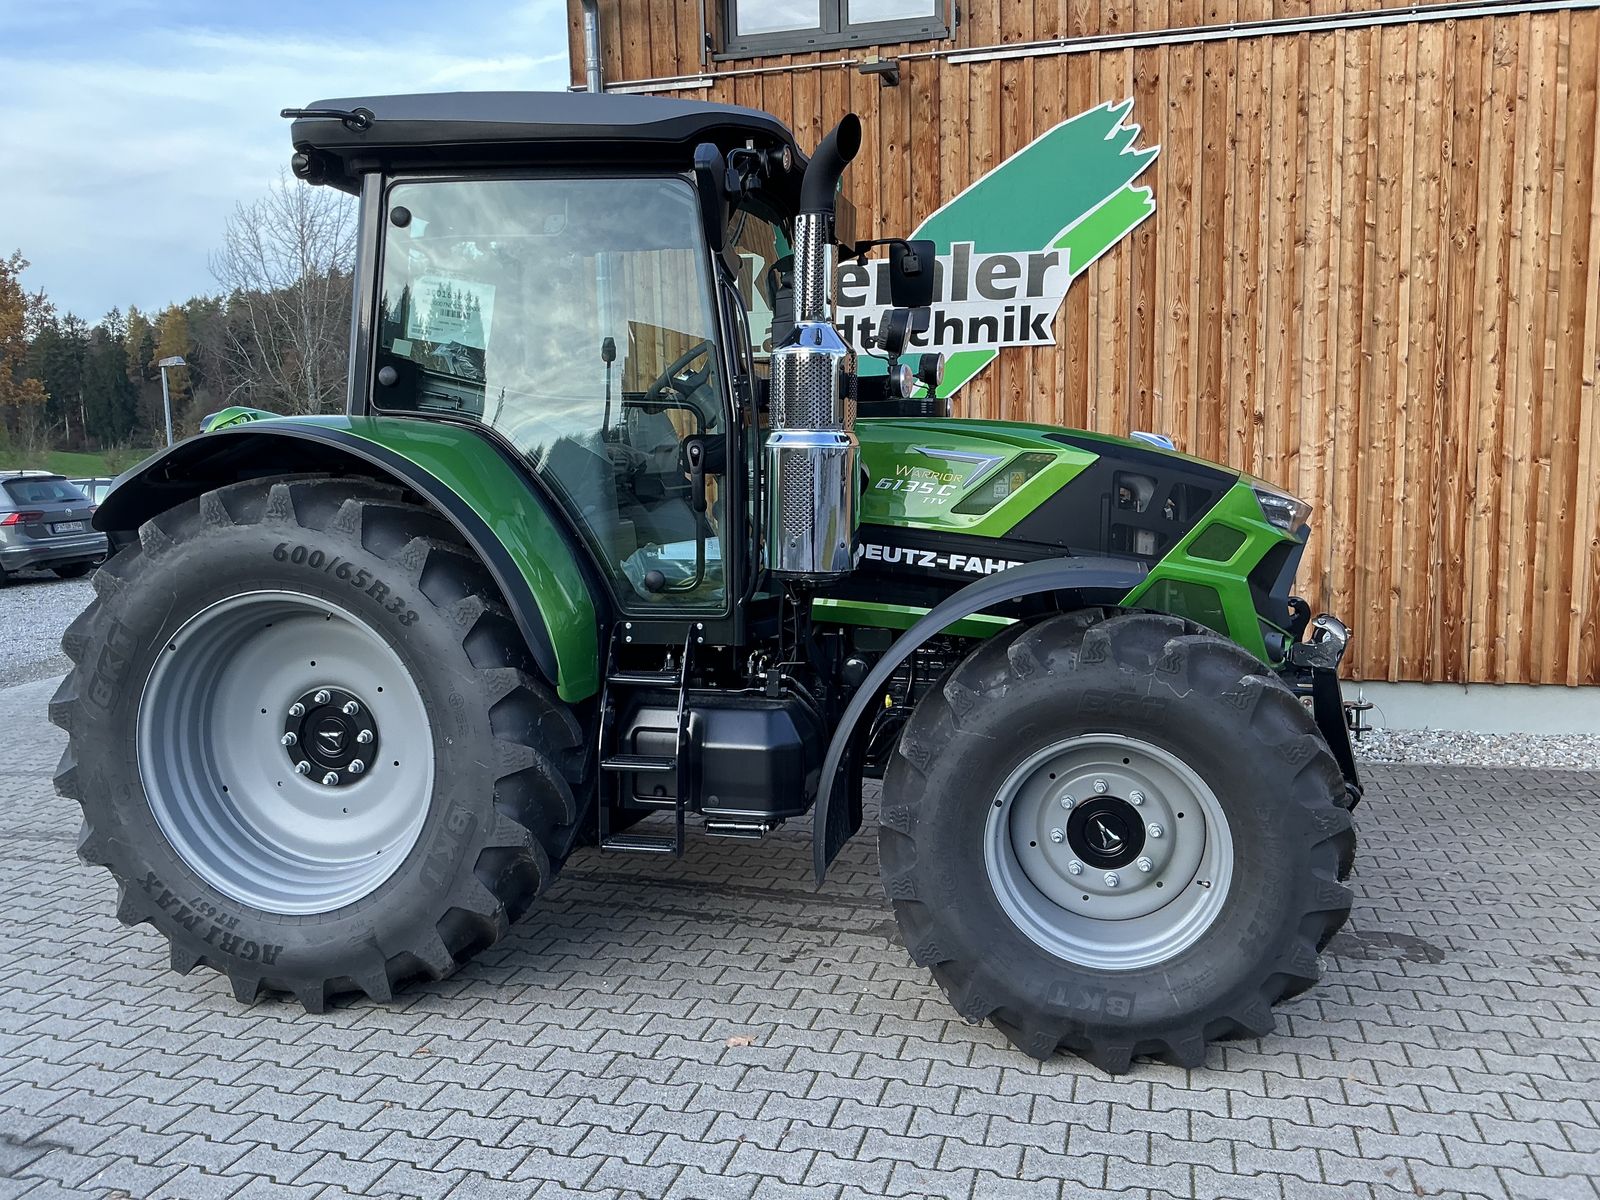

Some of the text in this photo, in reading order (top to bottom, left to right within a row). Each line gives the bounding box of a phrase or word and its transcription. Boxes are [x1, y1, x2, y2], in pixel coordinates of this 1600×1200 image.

[922, 497, 947, 505] TTV
[858, 543, 1024, 575] EUTZ-FAH
[273, 542, 420, 627] 600/65R38
